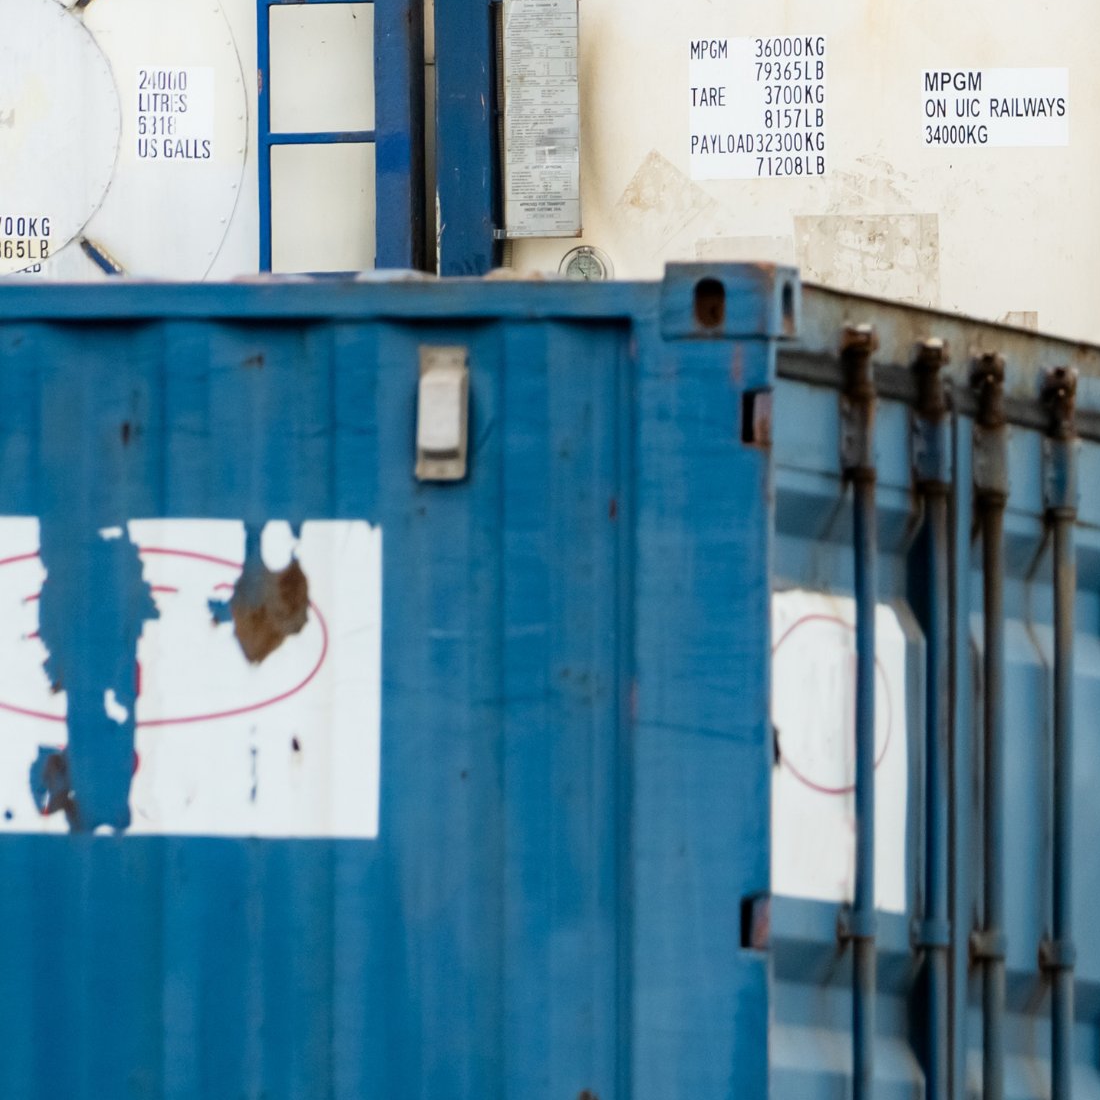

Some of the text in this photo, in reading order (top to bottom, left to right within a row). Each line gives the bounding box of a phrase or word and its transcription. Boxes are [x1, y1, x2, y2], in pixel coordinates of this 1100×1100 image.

[691, 37, 825, 59] MPGM 36000KG
[755, 61, 824, 81] 79365LB
[924, 72, 982, 92] MPGM
[138, 93, 187, 113] LITRES
[691, 85, 824, 107] TARE 3700KG
[925, 97, 1066, 118] ON UIC RAILWAYS
[765, 108, 824, 128] 8157LB
[925, 125, 988, 144] 34000KG
[138, 138, 211, 159] US GALLS
[756, 156, 825, 176] 71208LB
[0, 216, 50, 236] 00KG
[0, 240, 49, 259] 65LB
